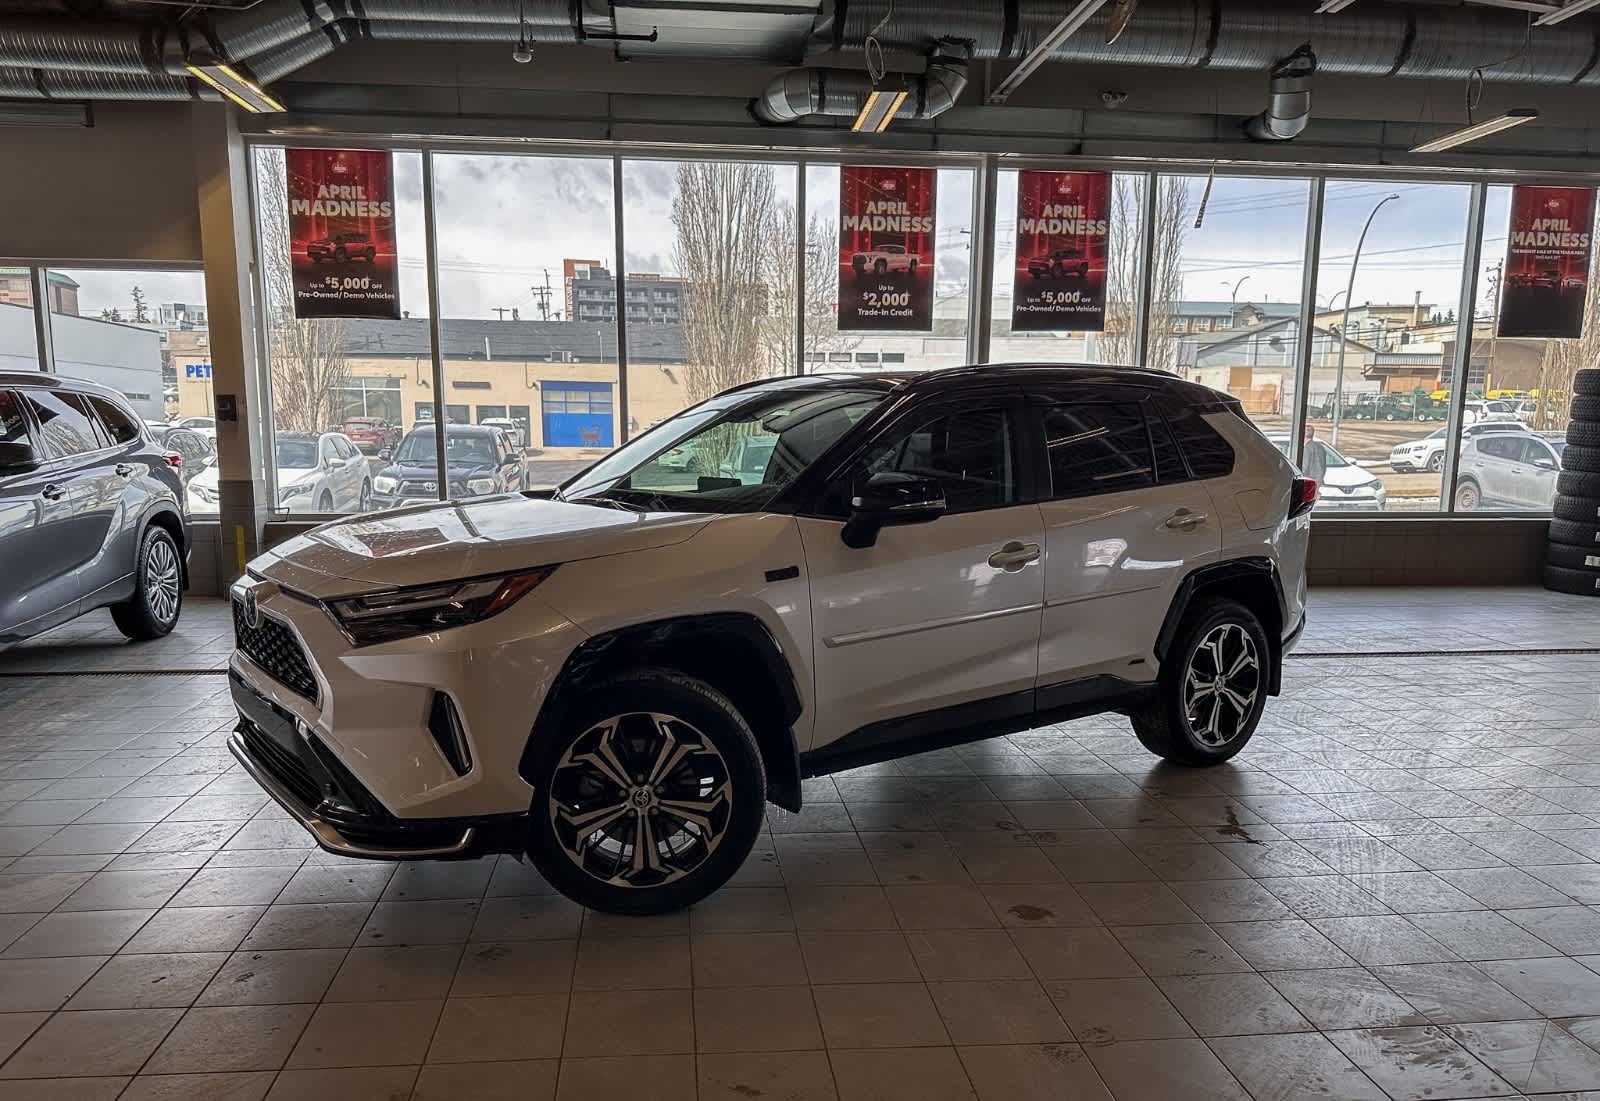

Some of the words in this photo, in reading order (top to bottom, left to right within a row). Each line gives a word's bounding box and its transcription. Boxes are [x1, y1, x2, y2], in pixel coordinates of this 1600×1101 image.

[317, 184, 367, 199] APRIL
[291, 199, 392, 217] MADNESS
[866, 201, 911, 215] APRIL
[1042, 204, 1086, 218] APRIL
[842, 215, 933, 233] MADNESS
[1019, 218, 1107, 235] MADNESS
[1531, 218, 1571, 231] APRIL
[1510, 231, 1590, 248] MADNESS
[863, 292, 909, 308] $2,000
[857, 308, 889, 316] Trade-In
[890, 309, 913, 317] Credit
[1075, 305, 1101, 313] Vehicles
